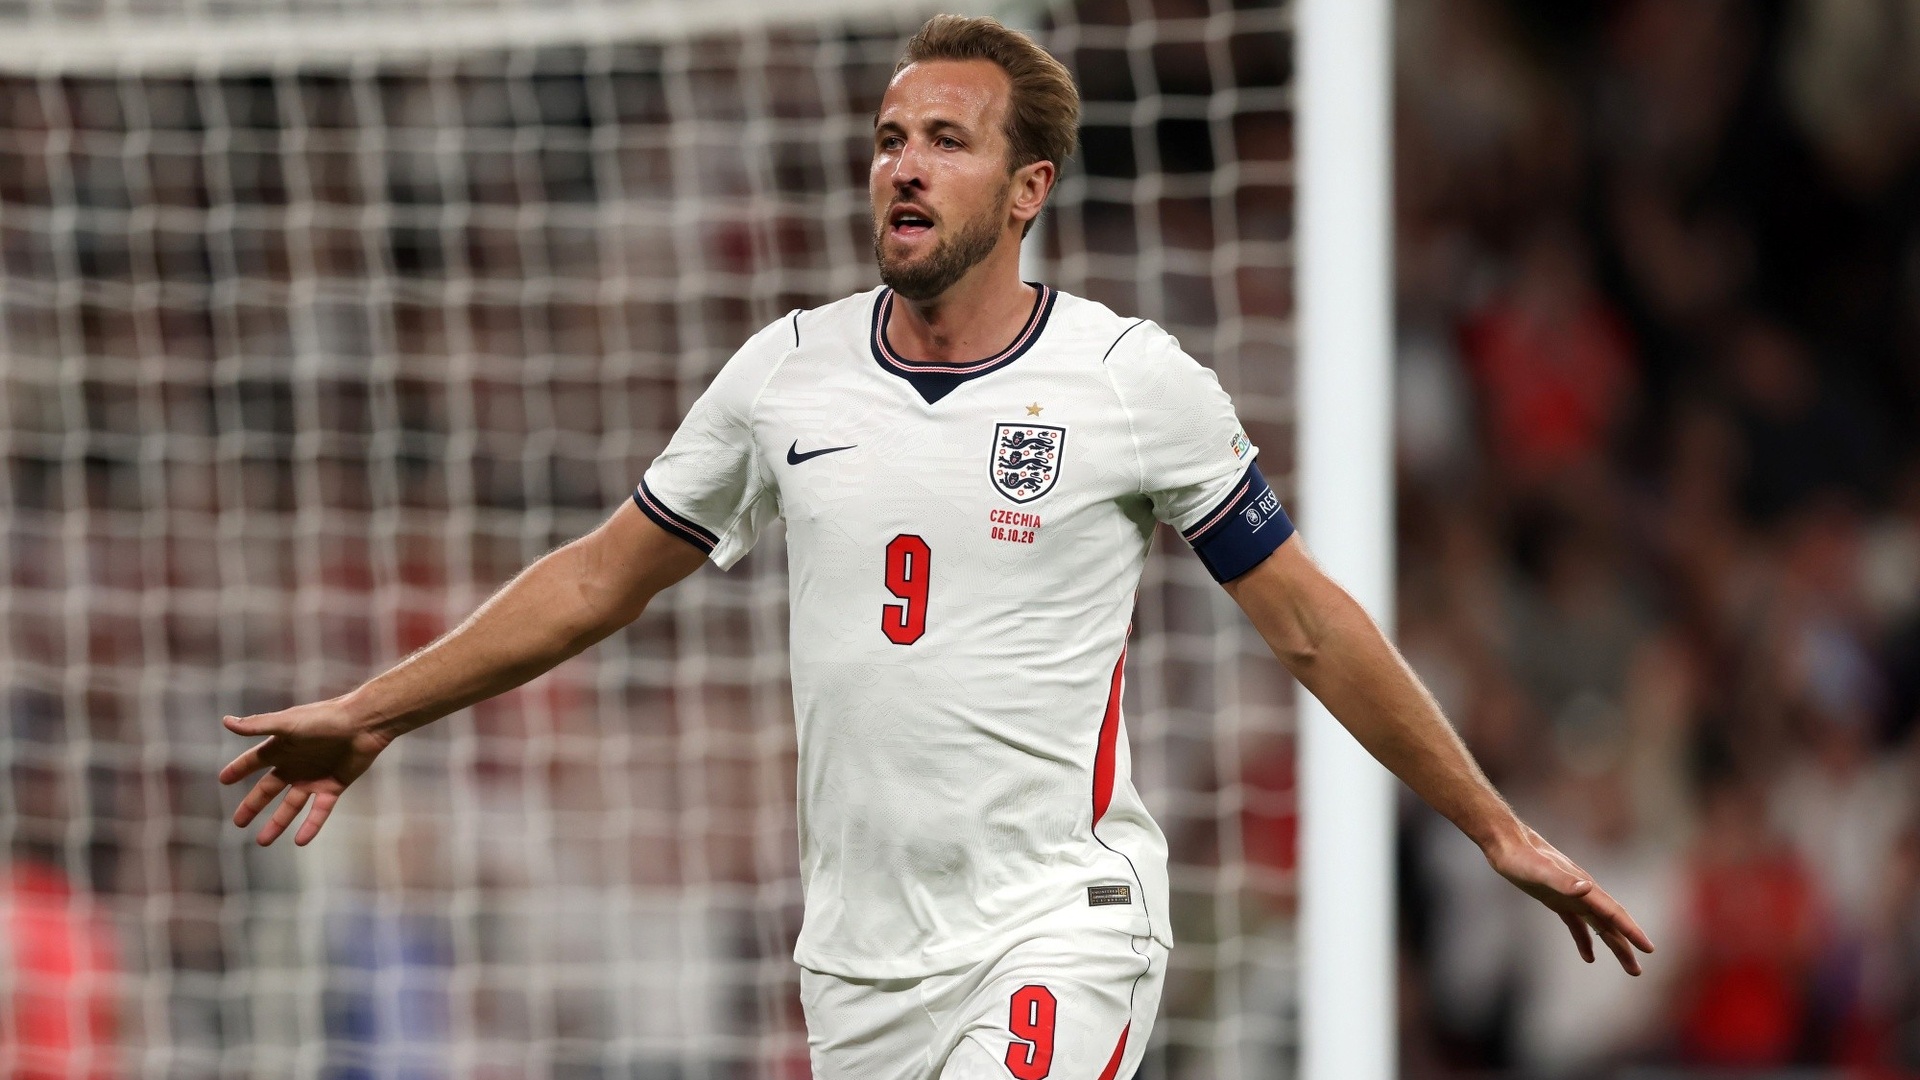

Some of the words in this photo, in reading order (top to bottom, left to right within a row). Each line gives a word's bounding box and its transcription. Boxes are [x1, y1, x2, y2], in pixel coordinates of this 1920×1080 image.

[990, 509, 1041, 528] CZECHIA
[991, 526, 1035, 544] 06.10.26
[881, 533, 931, 645] 9
[1004, 984, 1058, 1080] 9
